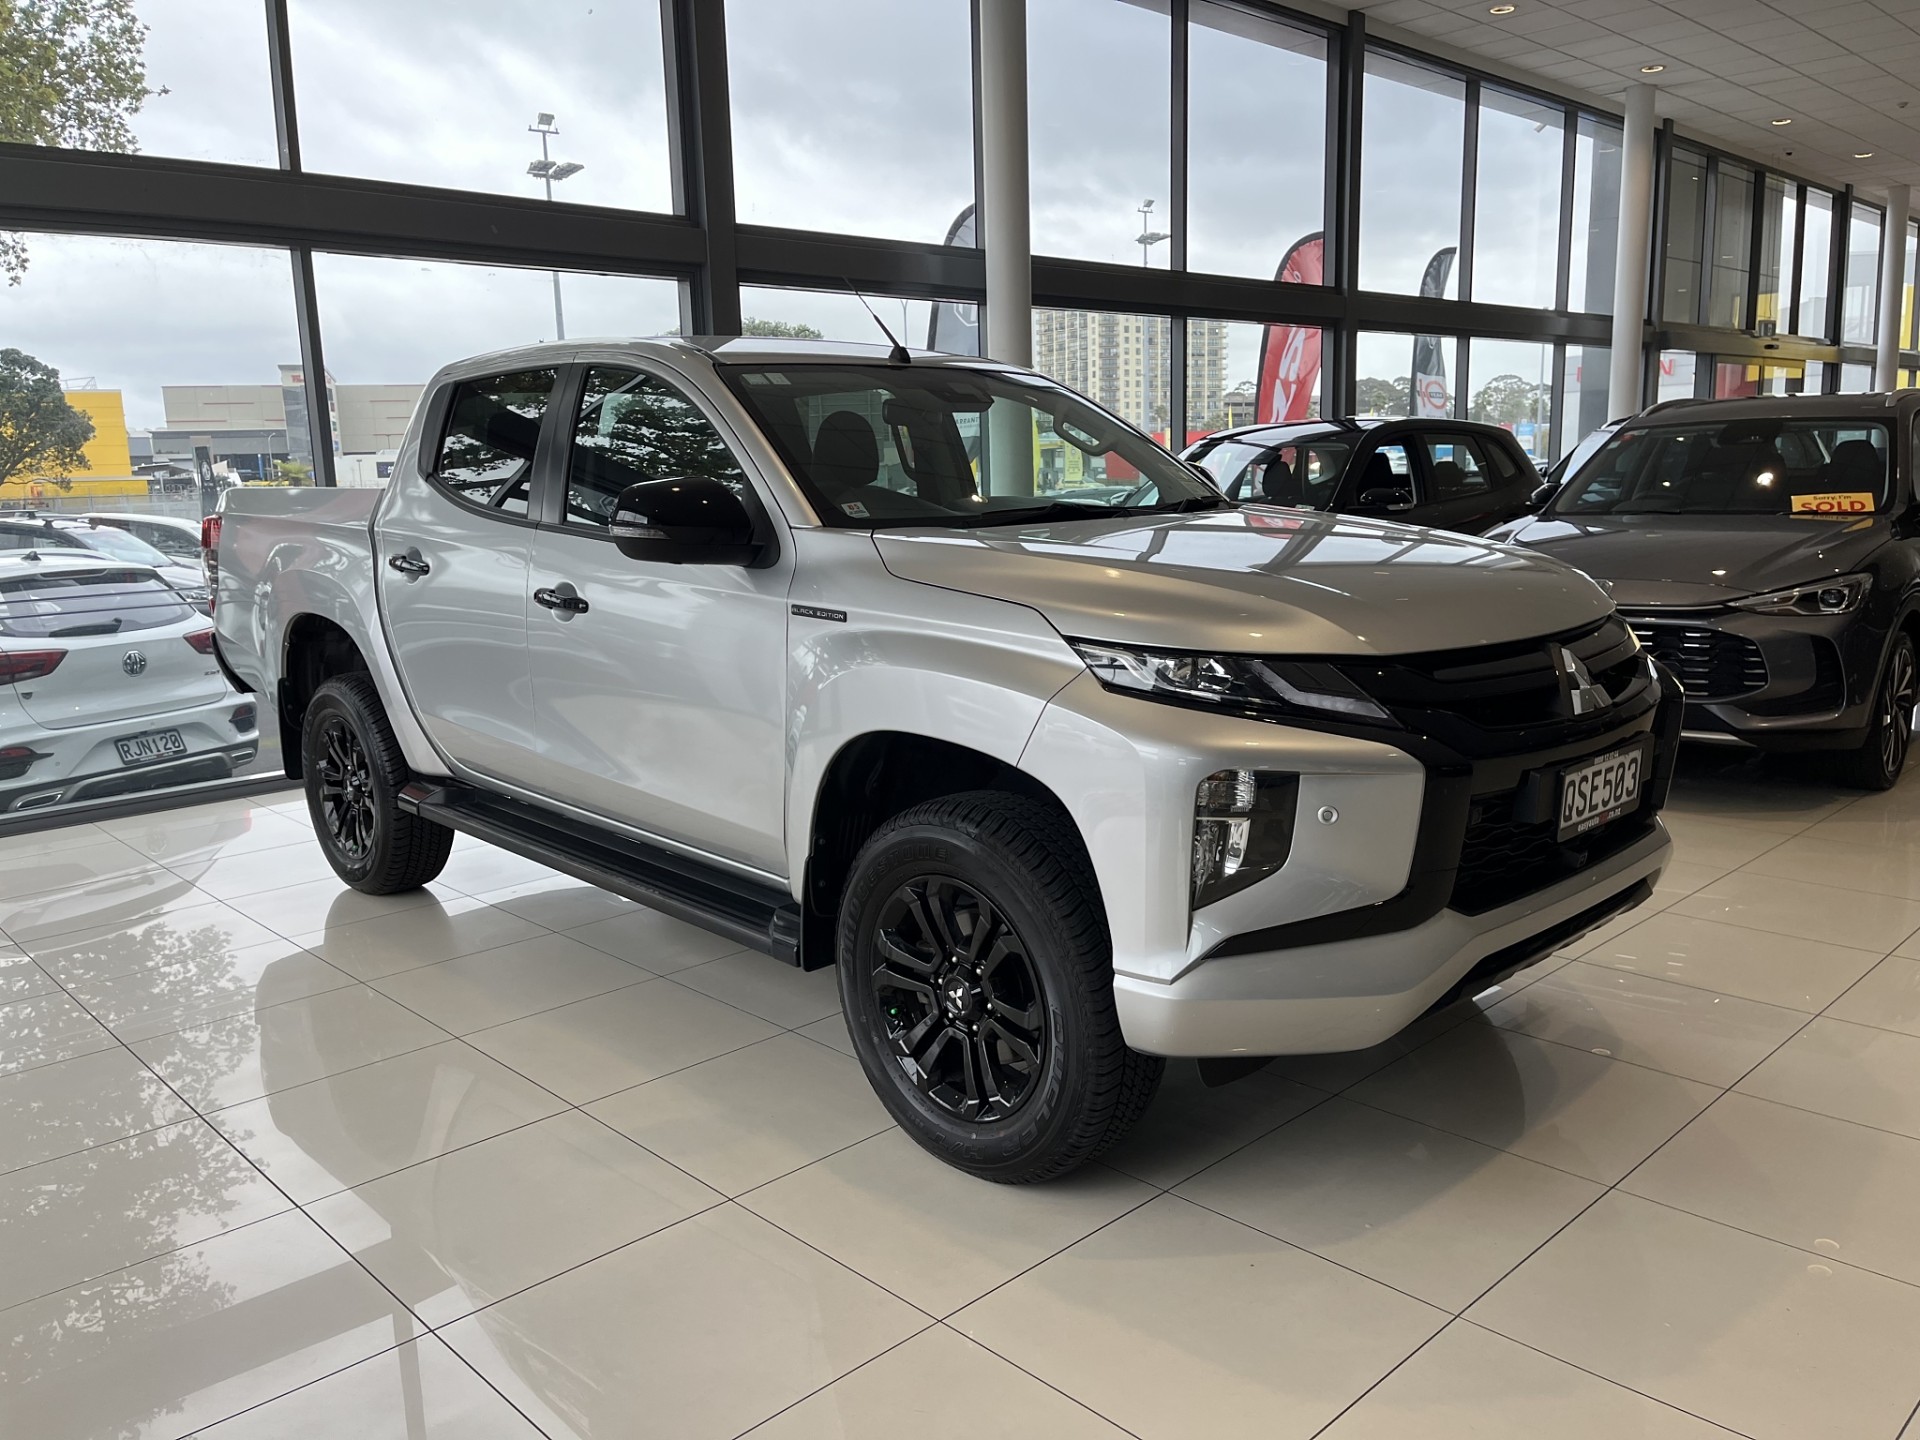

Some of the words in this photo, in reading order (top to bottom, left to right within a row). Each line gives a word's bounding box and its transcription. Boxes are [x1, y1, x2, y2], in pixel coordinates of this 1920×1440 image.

[1800, 500, 1866, 512] SOLD
[816, 611, 844, 619] EDITION
[120, 733, 181, 760] RJN120
[1563, 757, 1638, 823] QSE503
